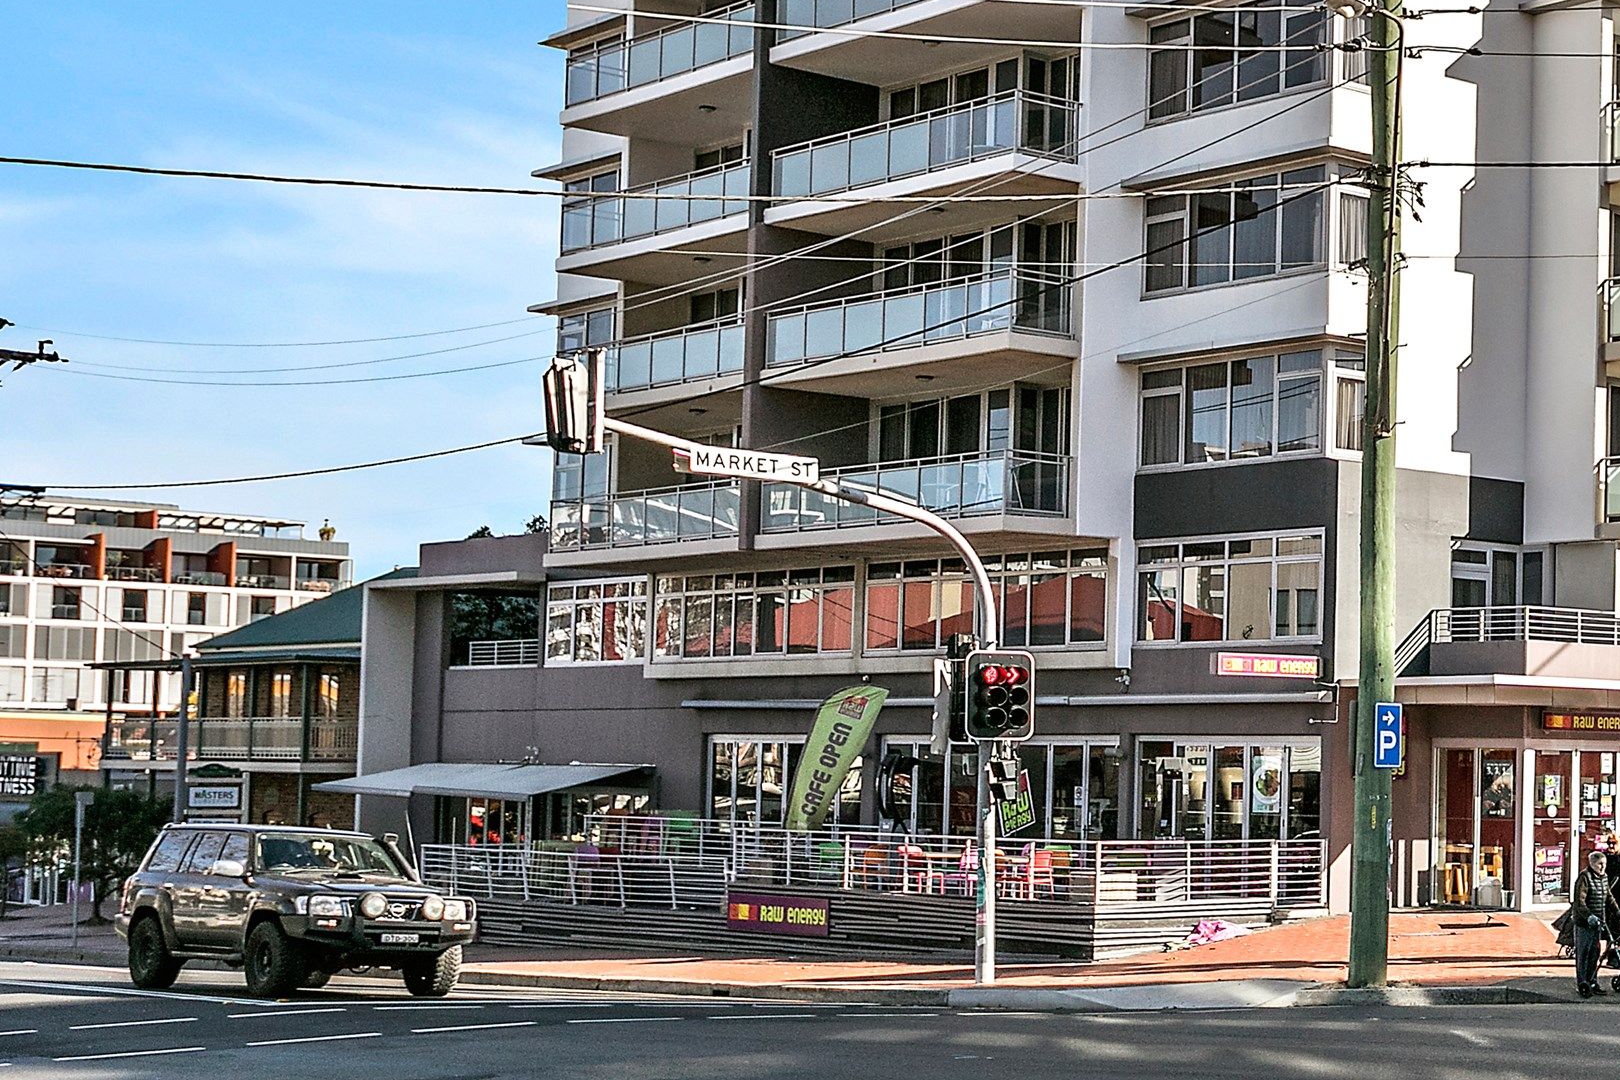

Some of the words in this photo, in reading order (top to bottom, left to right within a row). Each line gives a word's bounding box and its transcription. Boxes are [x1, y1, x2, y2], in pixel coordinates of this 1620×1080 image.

[696, 451, 778, 473] MARKET
[791, 461, 813, 477] ST
[1379, 730, 1397, 760] P
[801, 769, 832, 816] CAFE
[819, 722, 853, 768] OPEN
